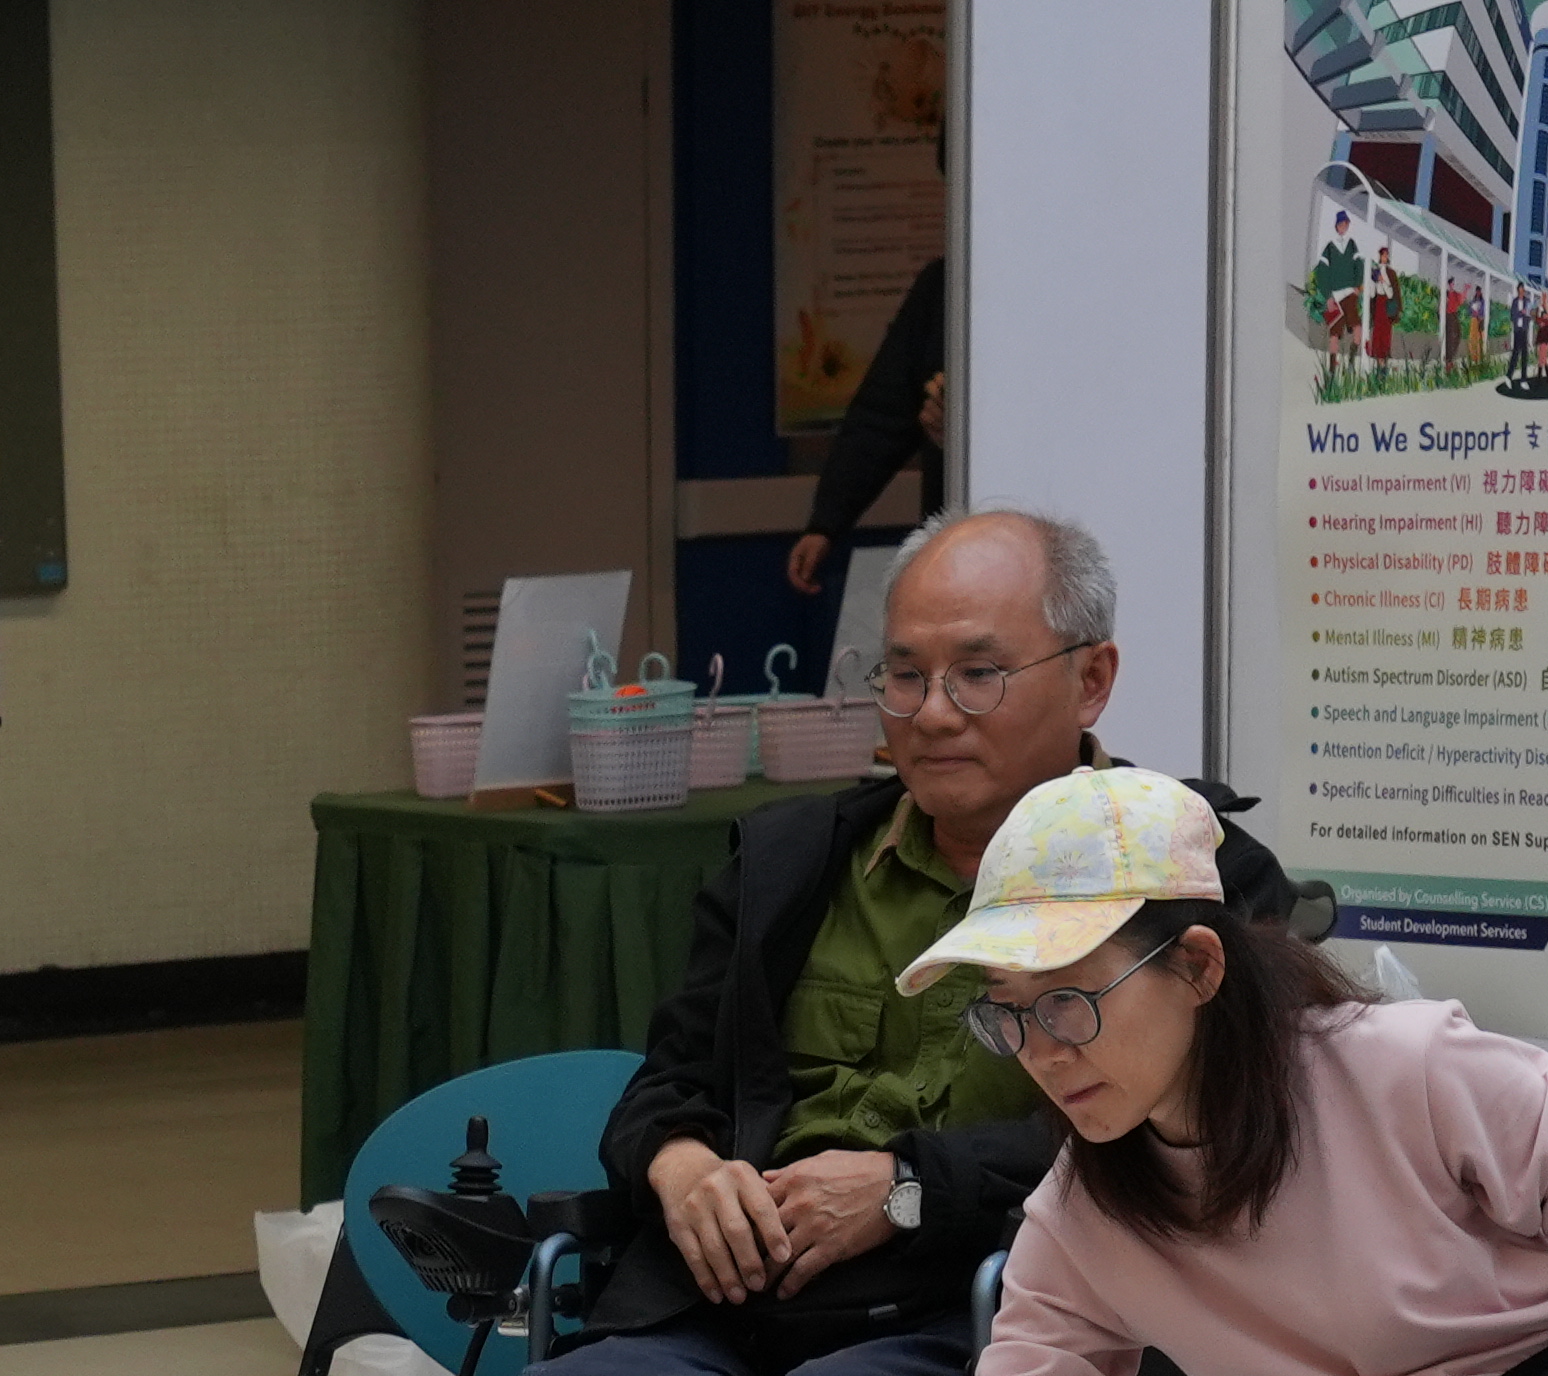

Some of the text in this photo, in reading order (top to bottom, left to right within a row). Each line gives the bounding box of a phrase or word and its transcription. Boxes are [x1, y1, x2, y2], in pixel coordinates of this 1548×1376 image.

[1306, 423, 1359, 453] Who
[1370, 422, 1408, 452] We
[1418, 421, 1511, 459] Support
[1321, 474, 1362, 492] Visual
[1366, 474, 1447, 495] Impairment
[1450, 473, 1470, 494] (VI)
[1322, 514, 1376, 535] Hearing
[1379, 513, 1457, 535] Impairment
[1461, 513, 1482, 533] (HI)
[1323, 552, 1379, 574] Physical
[1382, 553, 1444, 574] Disability
[1447, 553, 1473, 573] (PD)
[1323, 587, 1528, 612] Chronic Illness (CI) 長期病患
[1325, 625, 1523, 651] Mental Illness (MI) 精神病患
[1324, 666, 1369, 683] Autism
[1372, 667, 1433, 688] Spectrum
[1436, 669, 1490, 687] Disorder
[1492, 670, 1527, 690] (ASD)
[1324, 704, 1370, 724] Speech
[1373, 704, 1397, 723] and
[1400, 707, 1460, 729] Language
[1463, 708, 1539, 730] Impairment
[1322, 740, 1382, 759] Attention
[1386, 742, 1425, 760] Deficit
[1436, 744, 1522, 769] Hyperactivity
[1322, 780, 1371, 801] Specific
[1374, 783, 1429, 806] Learning
[1432, 784, 1500, 805] Difficulties
[1503, 787, 1515, 805] in
[1310, 822, 1332, 837] For
[1336, 823, 1387, 840] detailed
[1392, 826, 1466, 844] information
[1470, 833, 1487, 845] on
[1492, 830, 1520, 847] SEN
[1360, 914, 1527, 940] Student Development Services
